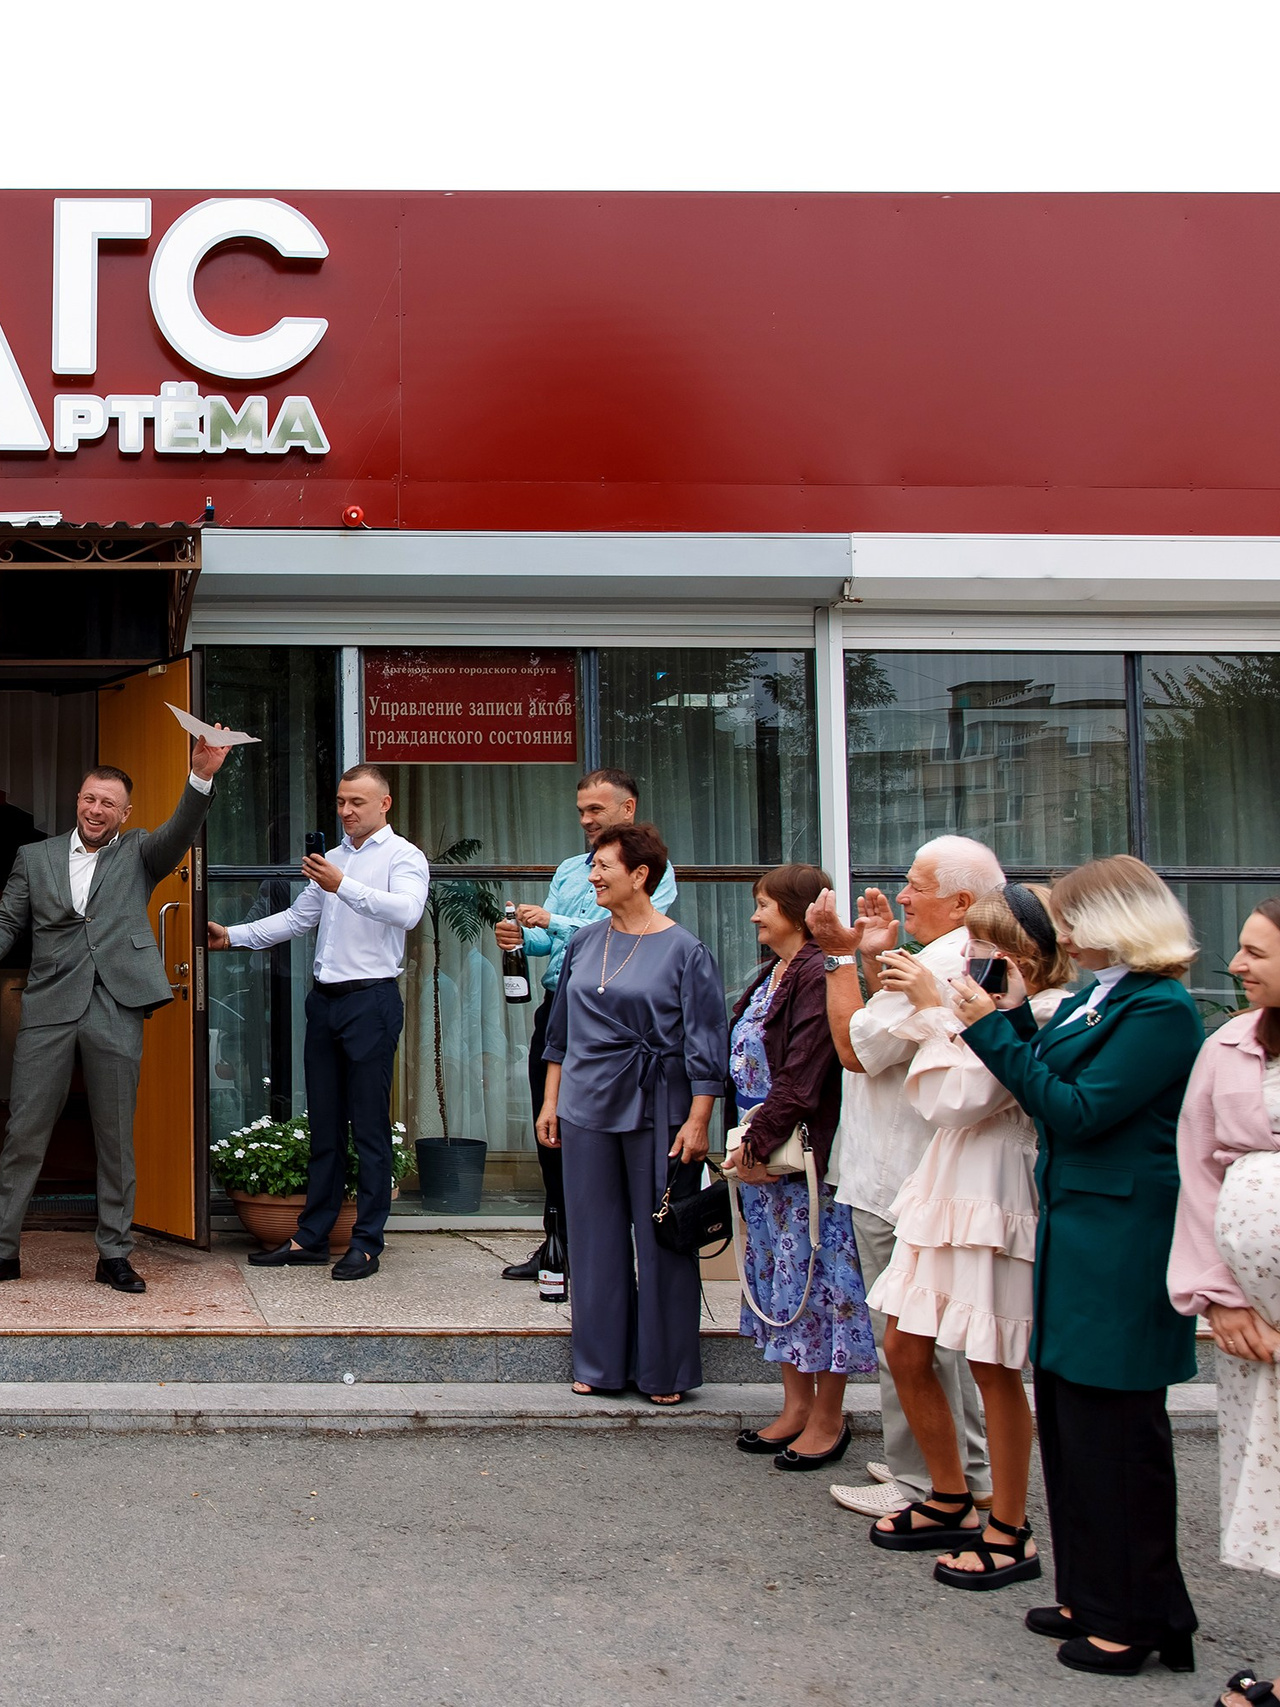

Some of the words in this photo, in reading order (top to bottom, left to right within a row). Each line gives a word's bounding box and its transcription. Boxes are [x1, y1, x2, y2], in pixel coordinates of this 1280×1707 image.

[459, 666, 517, 676] городского
[521, 666, 557, 676] округа
[369, 696, 463, 721] Управление
[468, 701, 522, 716] записи
[528, 700, 572, 717] актов
[369, 729, 483, 750] гражданского
[489, 729, 573, 745] состояния
